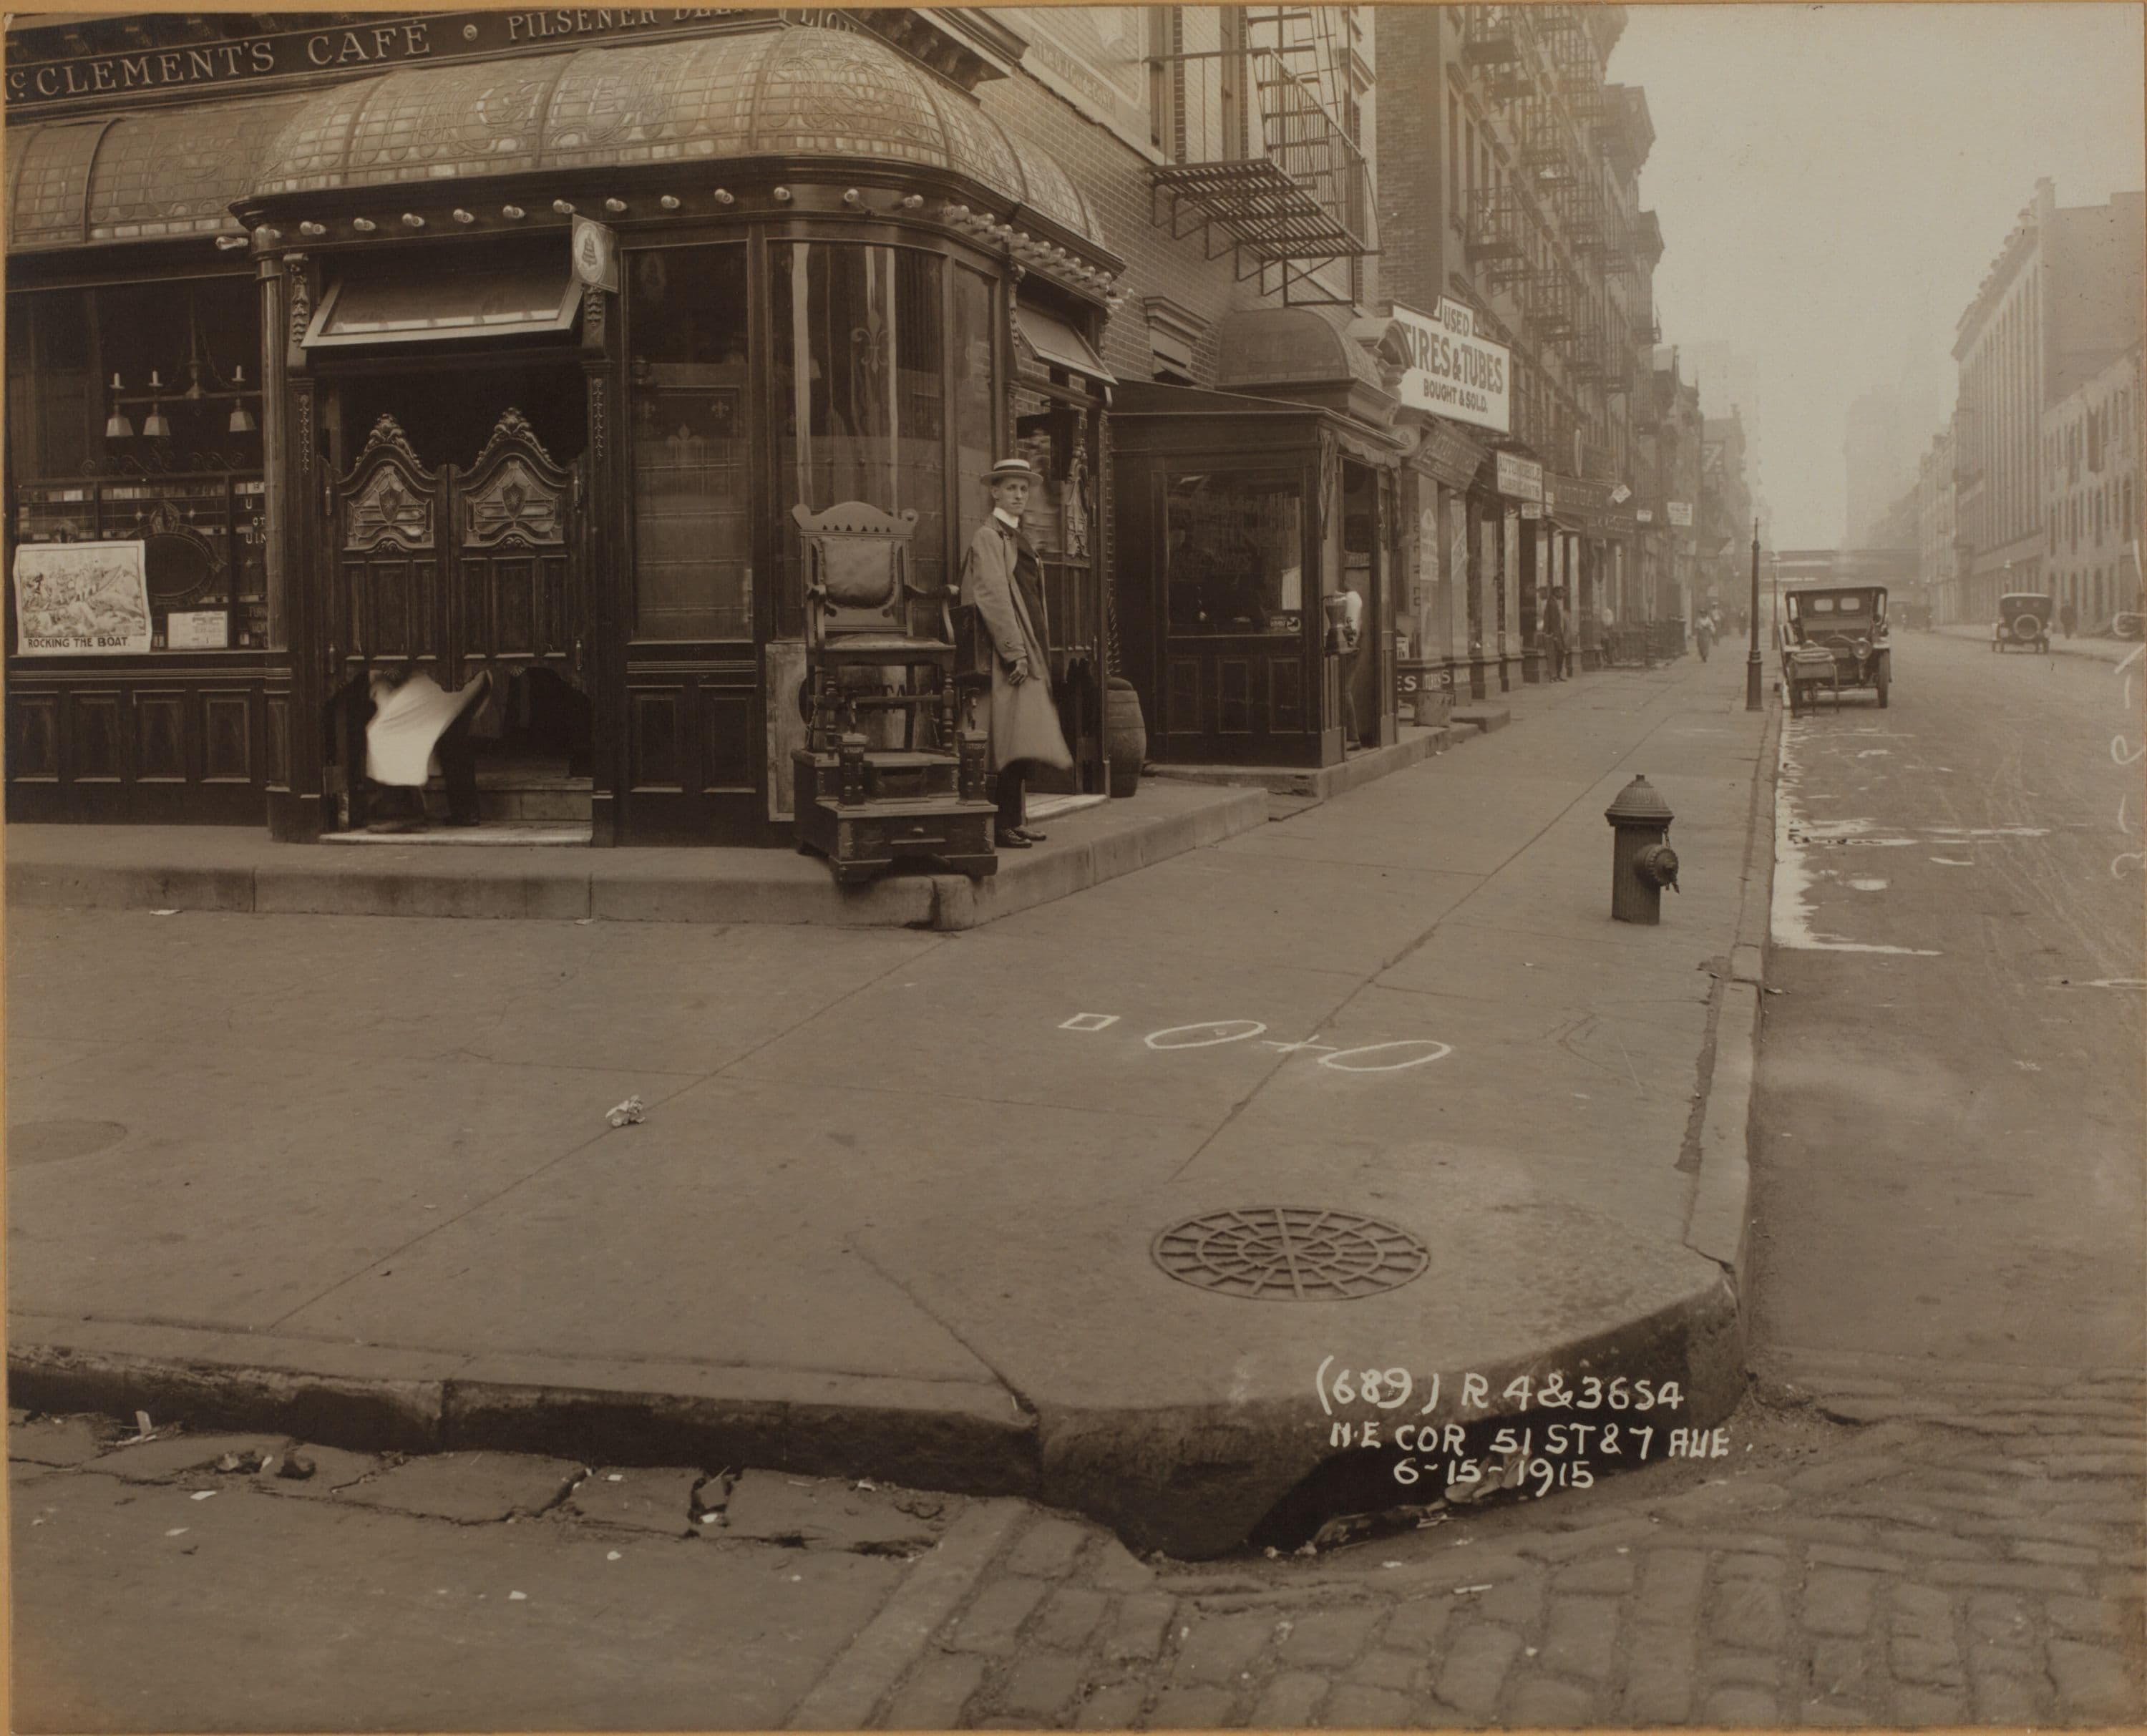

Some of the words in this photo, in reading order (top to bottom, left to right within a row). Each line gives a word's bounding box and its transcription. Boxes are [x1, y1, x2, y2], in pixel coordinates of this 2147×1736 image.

[1443, 306, 1469, 337] USED
[1423, 378, 1456, 404] BOUGHT
[28, 638, 69, 648] ROCKING
[74, 638, 92, 648] THE
